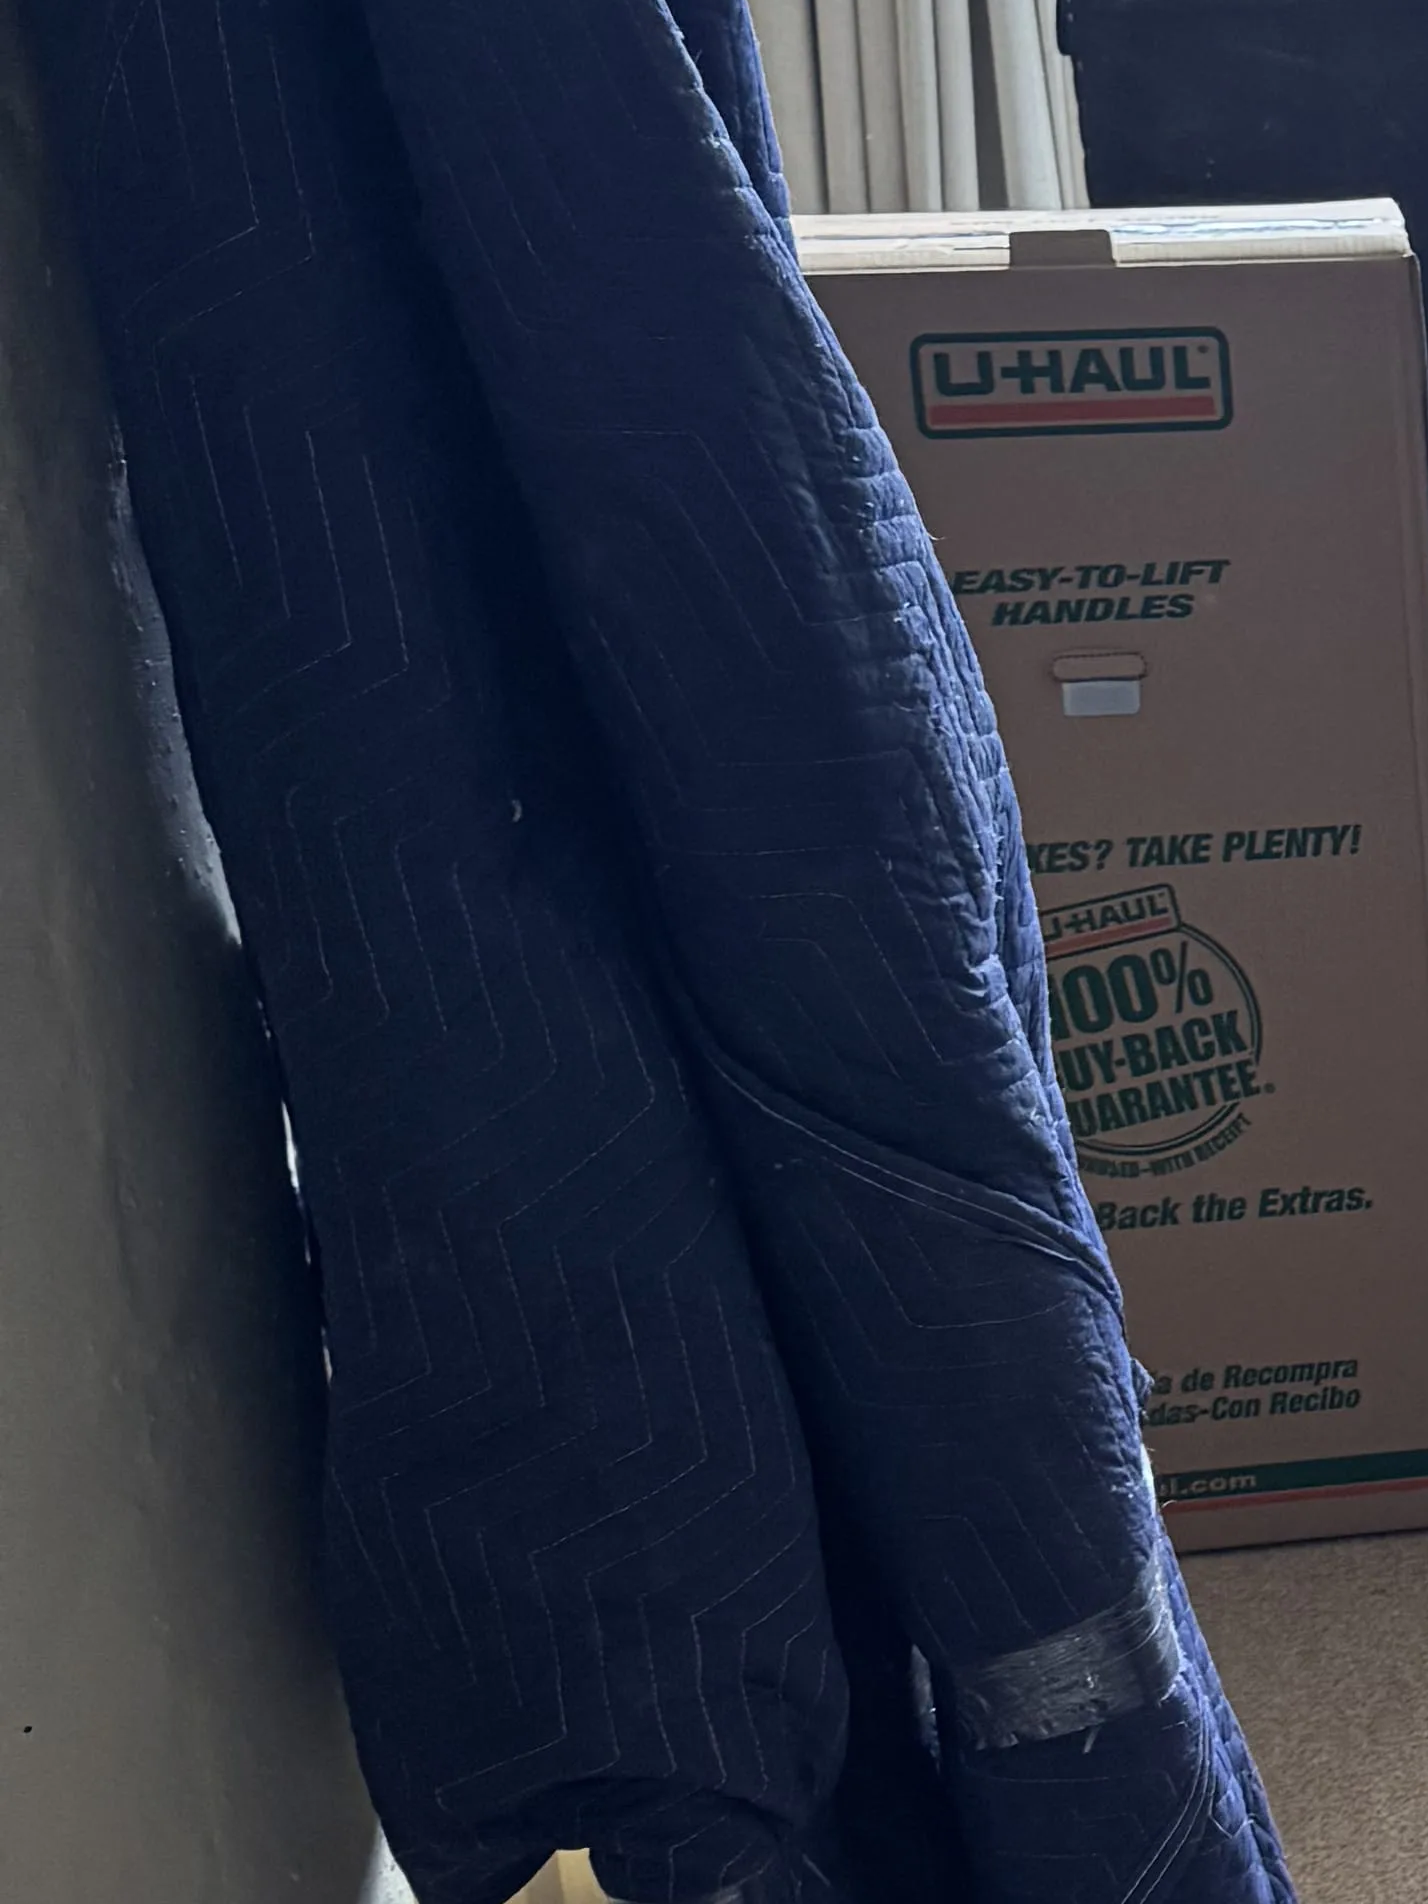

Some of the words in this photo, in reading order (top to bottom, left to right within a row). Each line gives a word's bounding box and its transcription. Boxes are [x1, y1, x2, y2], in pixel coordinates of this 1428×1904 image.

[932, 345, 1212, 397] U-HAUL
[953, 559, 1231, 595] EASY-TO-LIFT
[991, 594, 1195, 628] HANDLES
[1028, 838, 1114, 874] XES?
[1126, 833, 1213, 868] TAKE
[1222, 824, 1362, 863] PLENTY!
[1057, 1010, 1248, 1092] UY-BACK
[1069, 1059, 1262, 1138] UARANTEE
[1193, 1192, 1246, 1223] the
[1258, 1186, 1374, 1218] Extras.
[1181, 1368, 1214, 1392] de
[1224, 1359, 1358, 1389] Recompra
[1144, 1396, 1261, 1426] das-Con
[1269, 1385, 1361, 1414] Recibo
